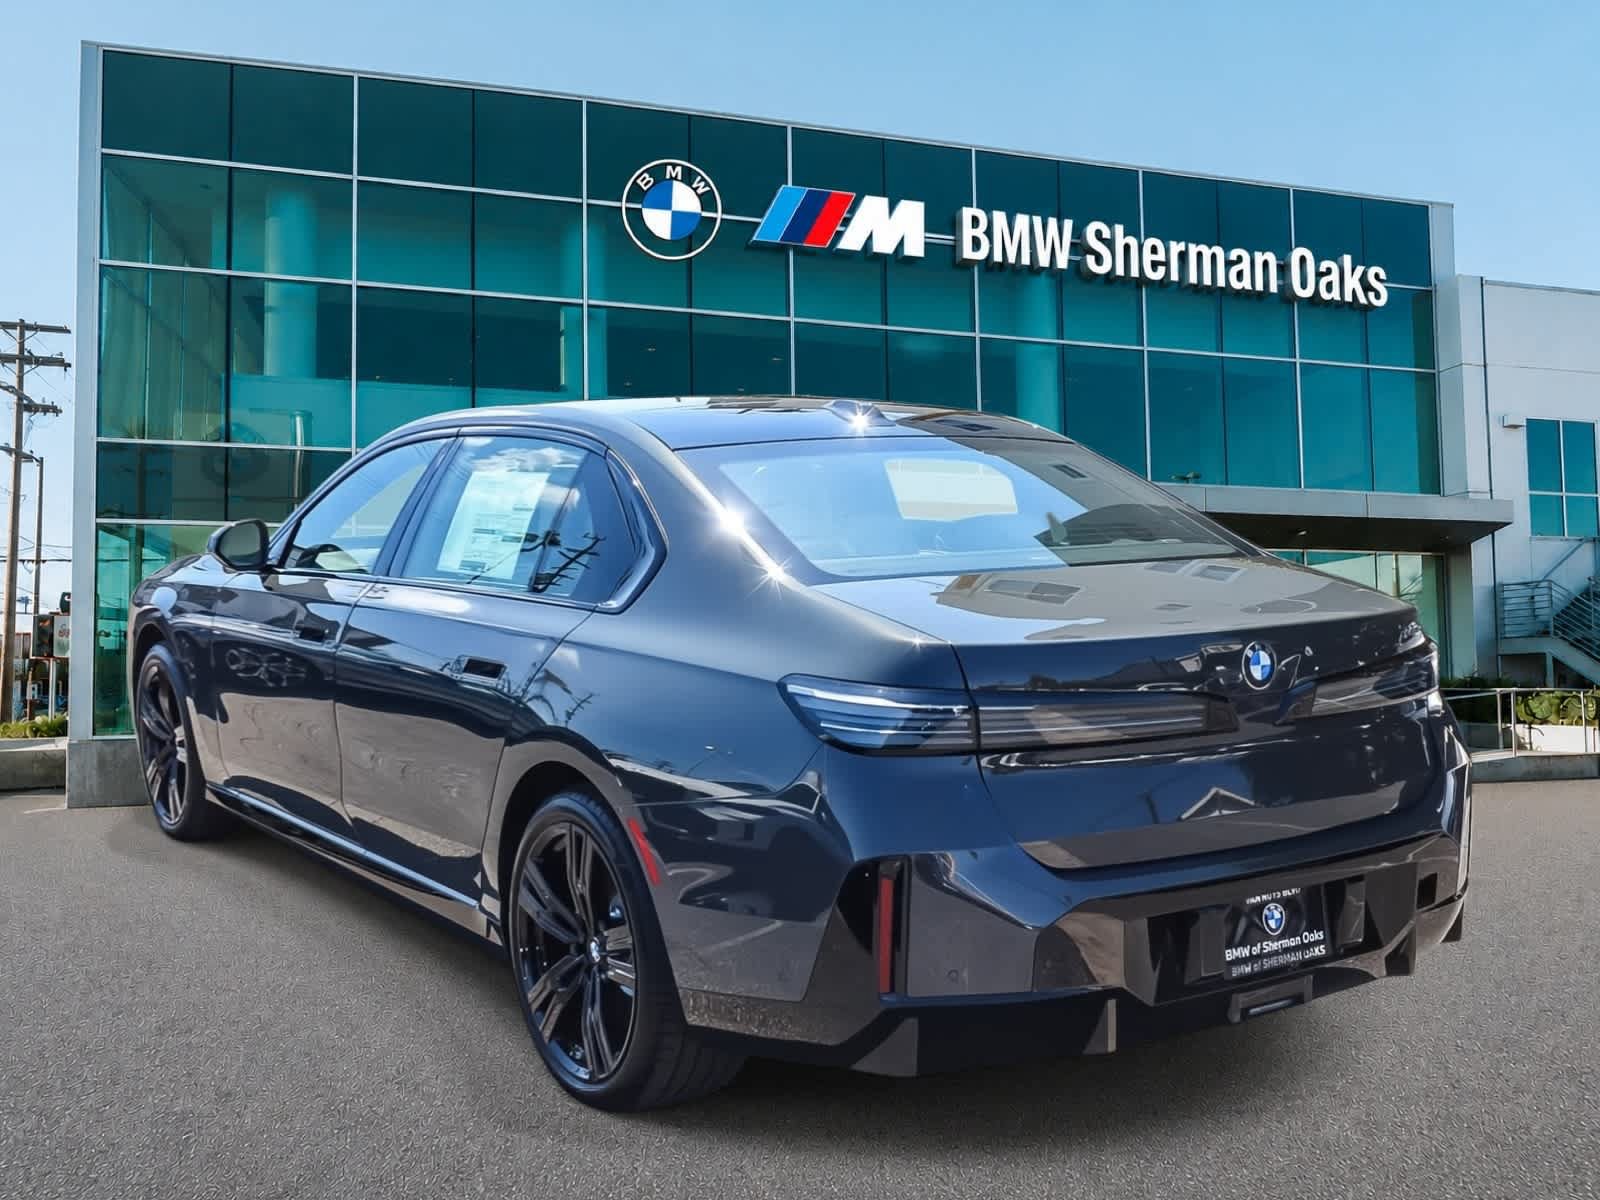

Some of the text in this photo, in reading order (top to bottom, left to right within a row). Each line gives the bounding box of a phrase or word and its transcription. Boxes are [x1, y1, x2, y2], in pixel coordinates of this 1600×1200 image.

[636, 165, 711, 195] BMW
[836, 195, 925, 257] M
[960, 206, 1389, 308] BMW Sherman Oaks
[1225, 929, 1324, 961] BMW of Sherman Oaks
[1303, 944, 1326, 959] OAKS
